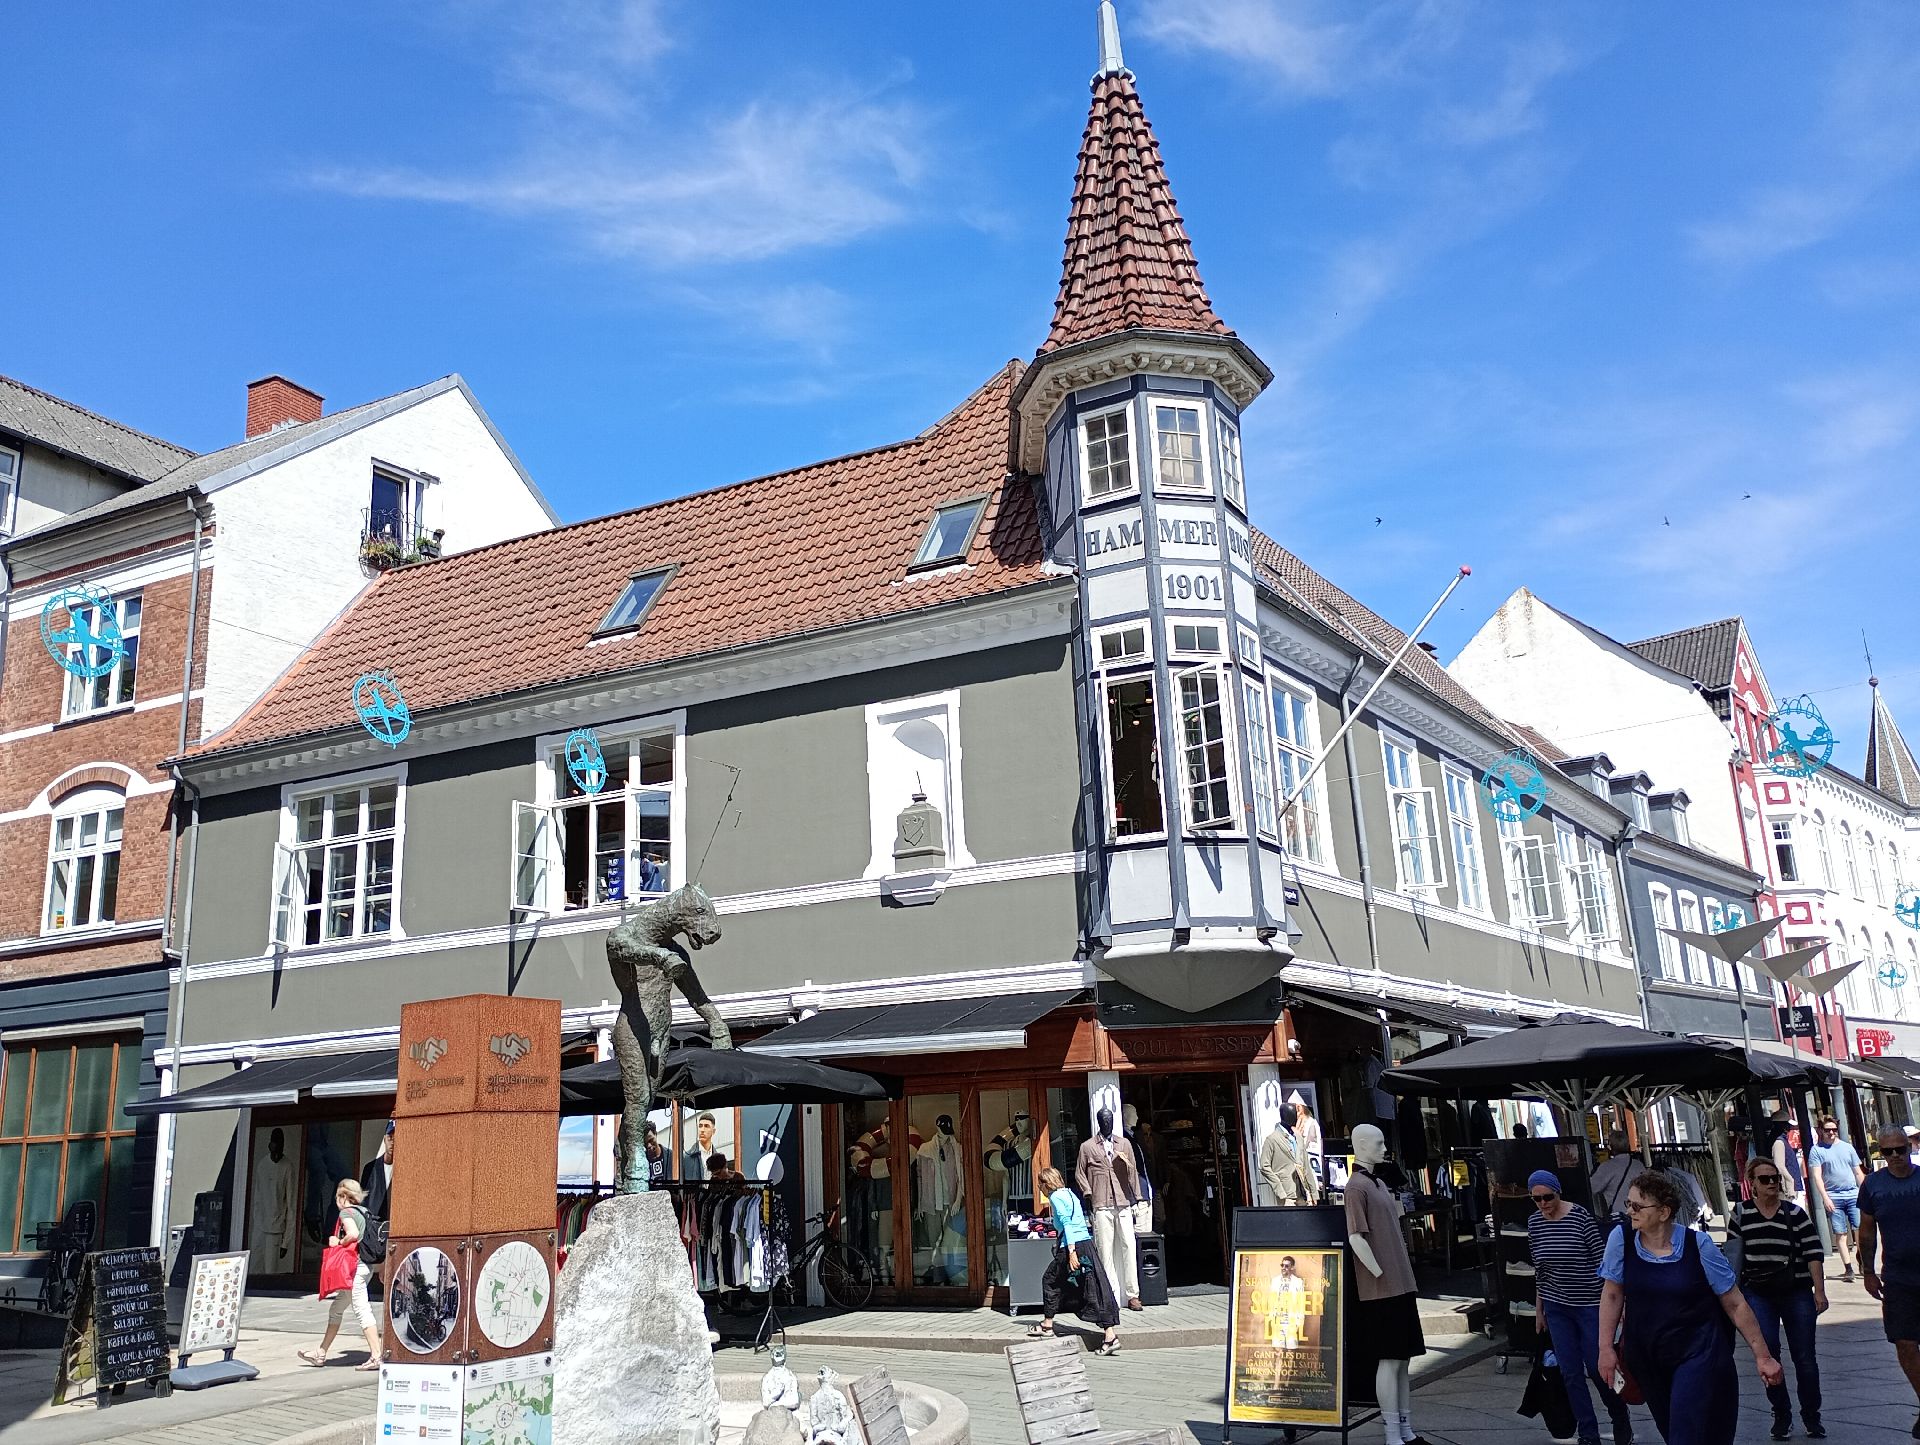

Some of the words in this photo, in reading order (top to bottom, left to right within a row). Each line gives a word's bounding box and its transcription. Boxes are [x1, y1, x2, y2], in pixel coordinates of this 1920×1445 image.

[1165, 574, 1222, 601] 1901
[1121, 1039, 1175, 1057] POUL
[1181, 1035, 1265, 1054] IVERSEN
[1253, 1351, 1275, 1359] GANT
[1296, 1352, 1318, 1360] DEUX
[1299, 1361, 1325, 1370] SMITH
[1245, 1367, 1299, 1377] BIRKENSTOCK
